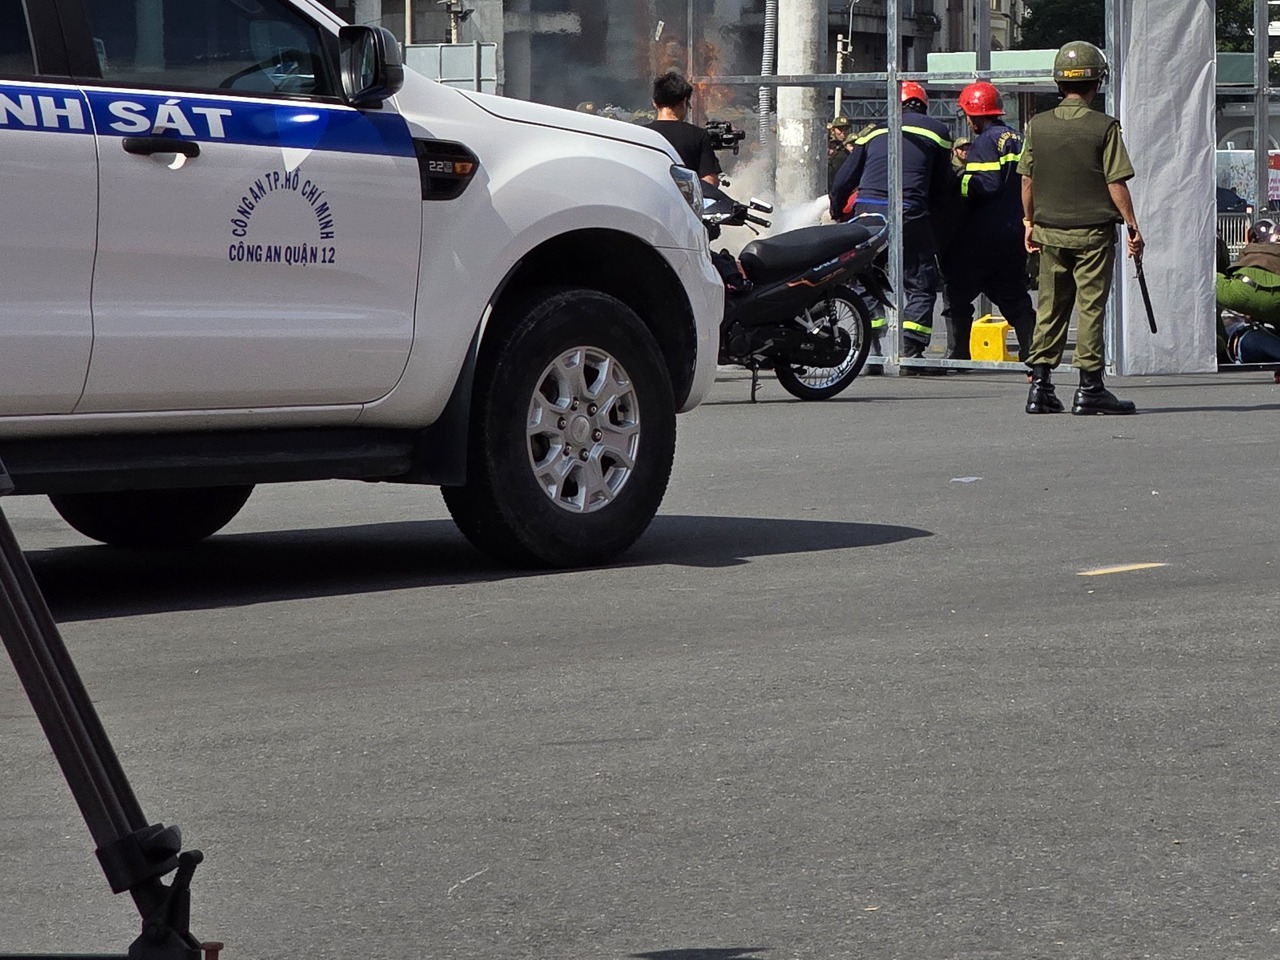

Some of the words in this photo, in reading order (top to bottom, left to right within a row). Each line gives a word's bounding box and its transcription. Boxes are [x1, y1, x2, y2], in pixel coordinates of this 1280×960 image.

[108, 99, 232, 139] SÁT
[231, 196, 256, 238] CÔNG
[249, 178, 267, 203] AN
[301, 180, 325, 206] CHÍ
[314, 201, 335, 240] MINH
[229, 241, 263, 262] CÔNG
[265, 245, 281, 263] AN
[284, 242, 318, 267] QUẬN
[321, 246, 336, 264] 12
